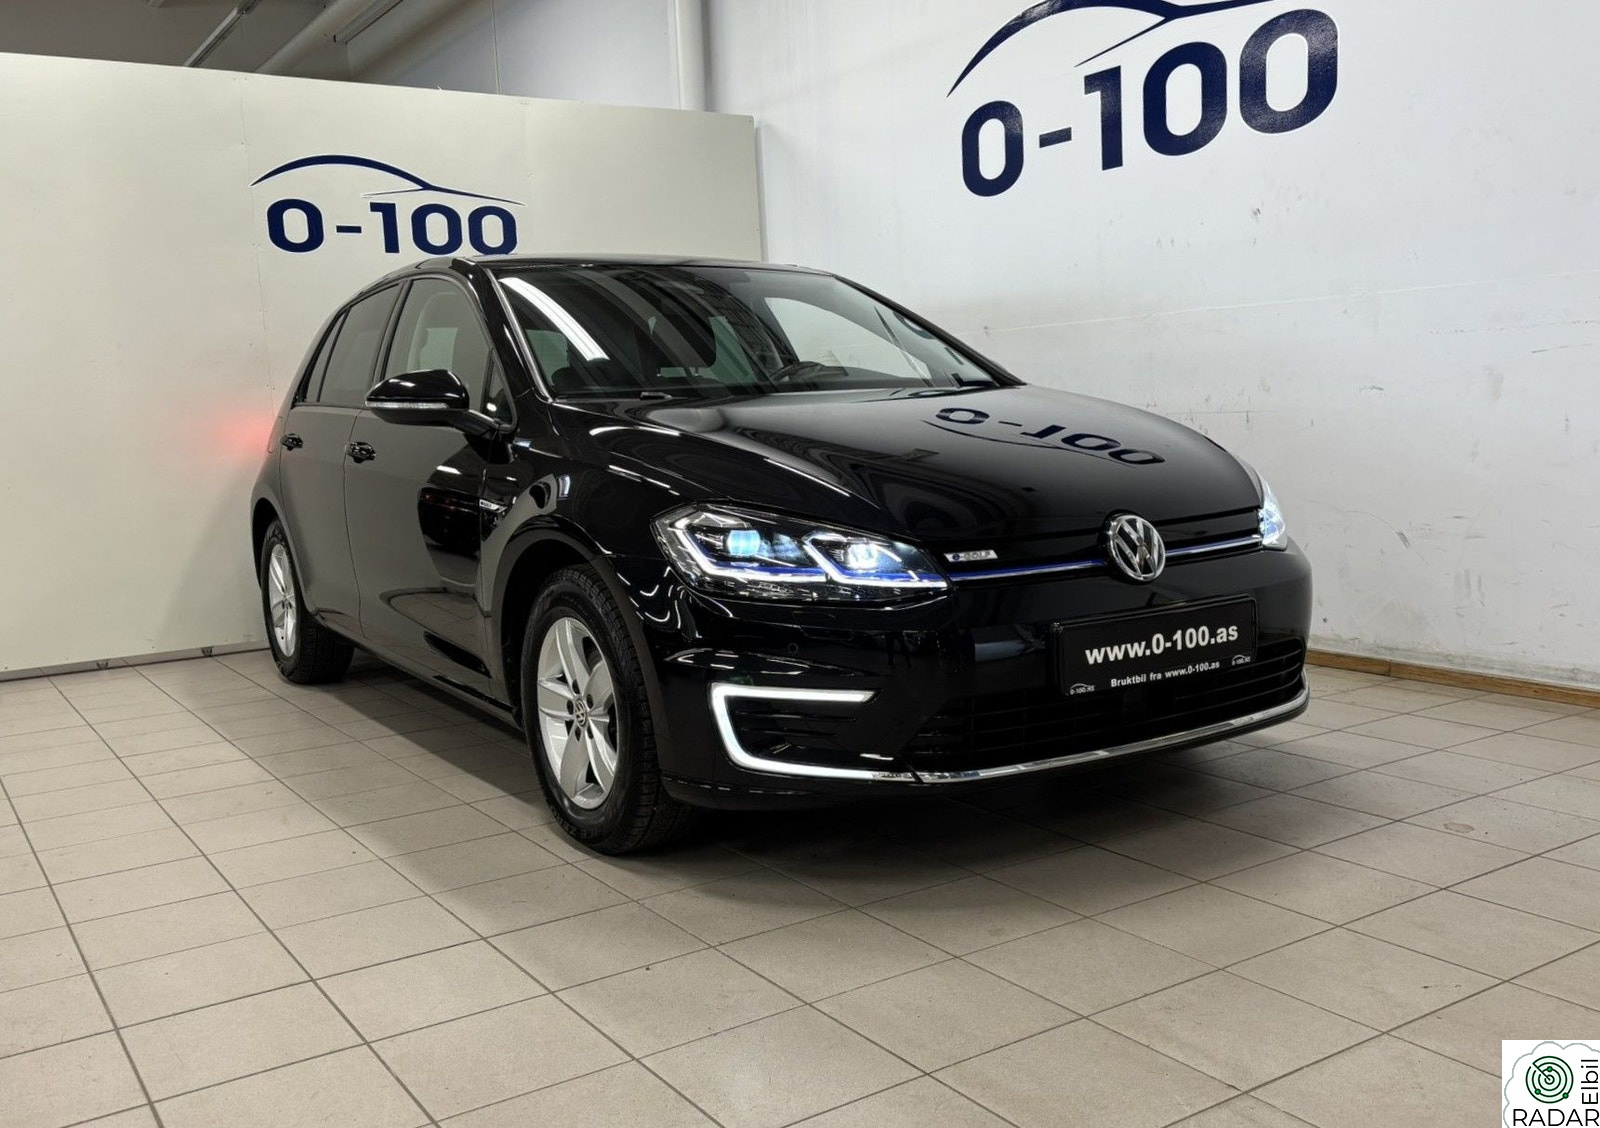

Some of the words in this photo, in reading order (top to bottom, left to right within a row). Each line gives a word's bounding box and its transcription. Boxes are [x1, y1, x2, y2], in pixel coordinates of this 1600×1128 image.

[962, 9, 1338, 197] 0-100
[266, 198, 518, 256] 0-100
[1085, 625, 1239, 665] www.0-100.as
[1111, 673, 1147, 688] Bruktbil
[1149, 672, 1163, 682] fra
[1165, 660, 1220, 679] www.0-100.as
